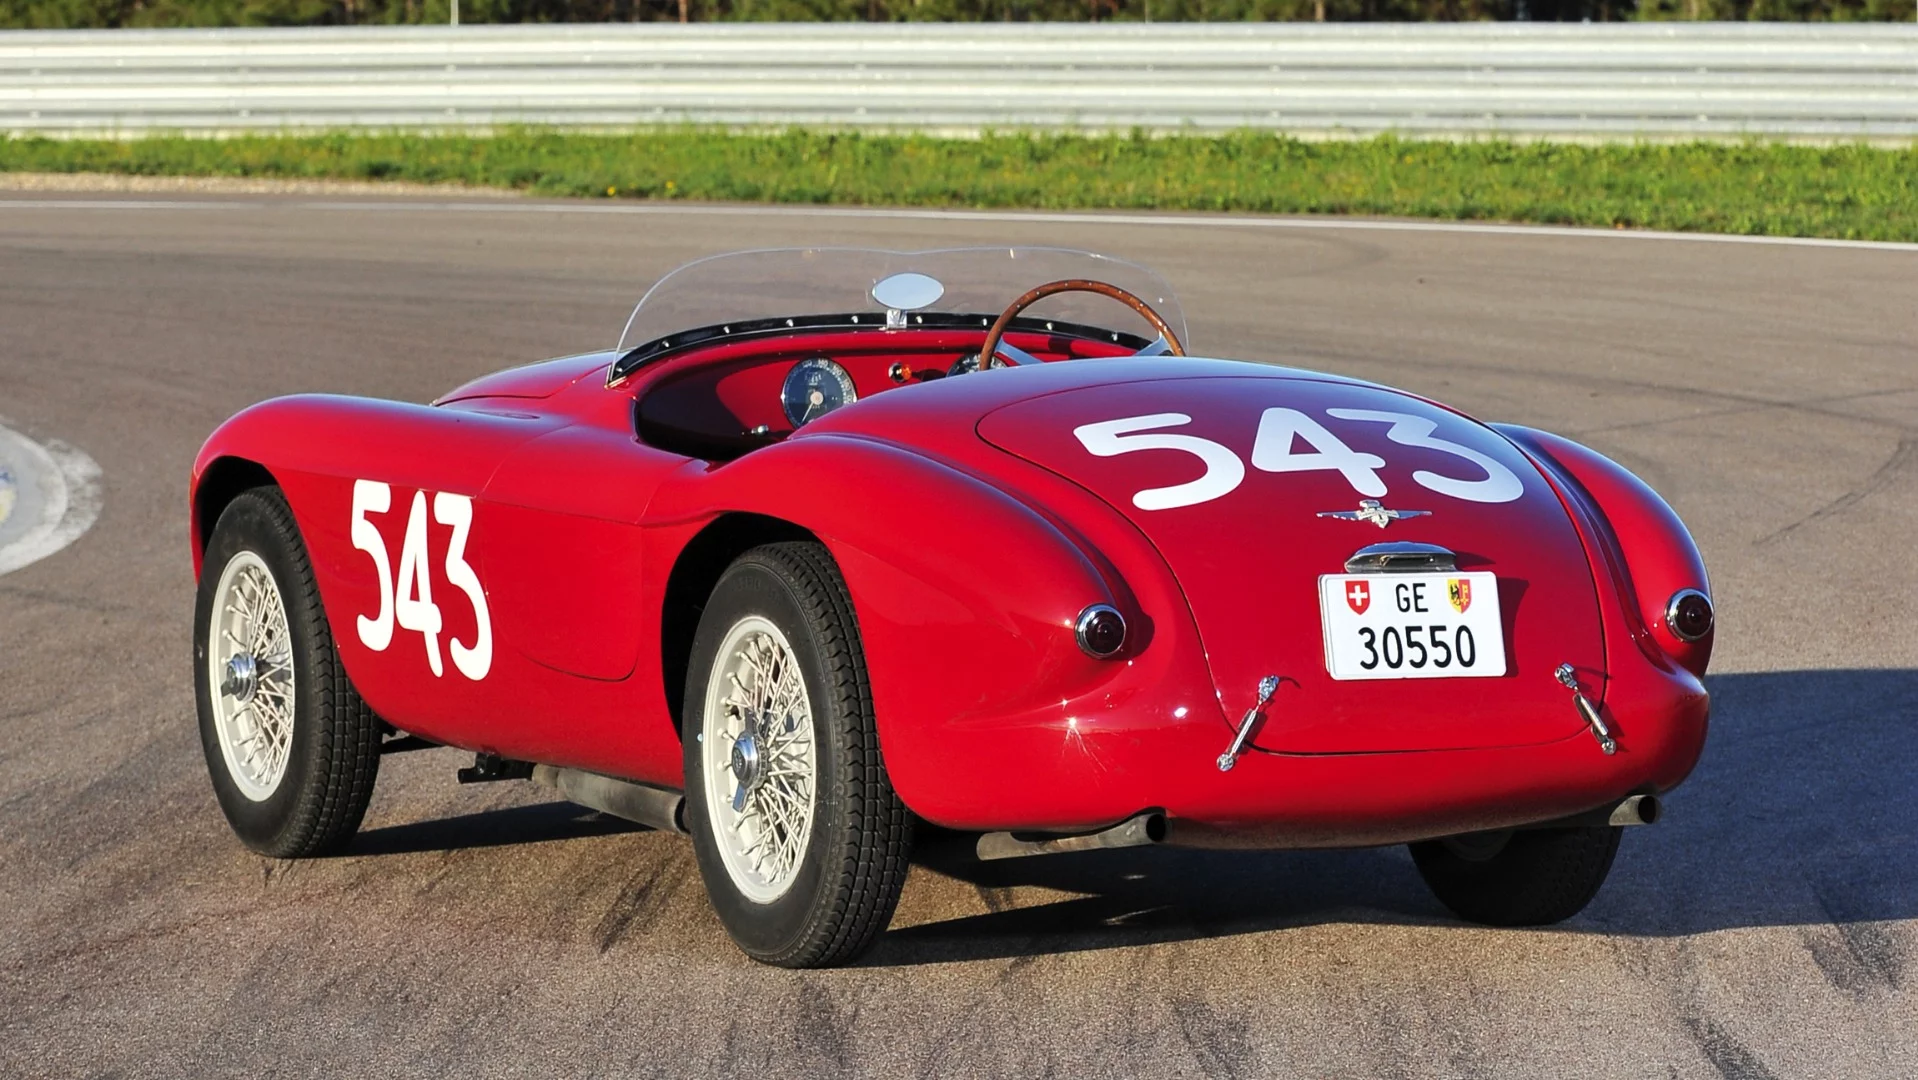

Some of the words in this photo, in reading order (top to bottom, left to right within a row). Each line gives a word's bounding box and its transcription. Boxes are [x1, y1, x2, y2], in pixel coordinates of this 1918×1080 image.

[1073, 407, 1524, 511] 543
[351, 479, 493, 681] 543
[1395, 582, 1429, 613] GE
[1358, 624, 1476, 670] 30550
